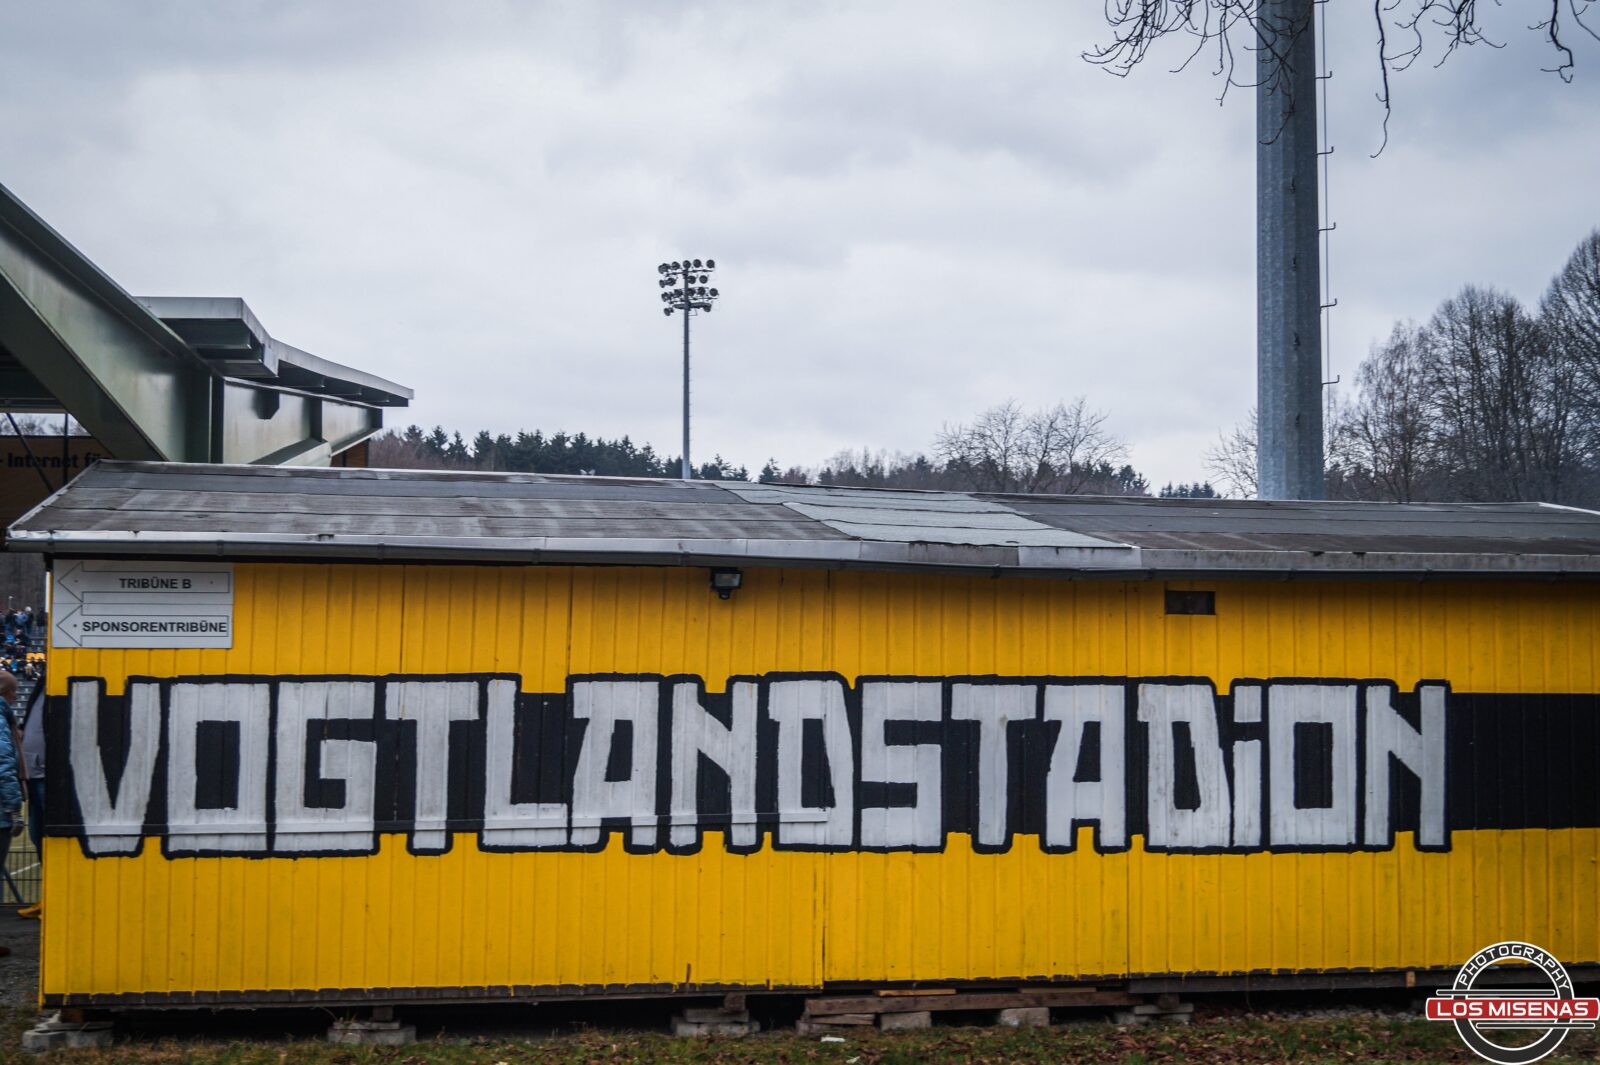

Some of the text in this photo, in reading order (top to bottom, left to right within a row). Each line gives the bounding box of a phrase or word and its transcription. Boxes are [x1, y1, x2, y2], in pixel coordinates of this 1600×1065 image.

[119, 576, 192, 589] TRIBÜNE B
[82, 620, 227, 633] SPONSORENTRIBÜNE
